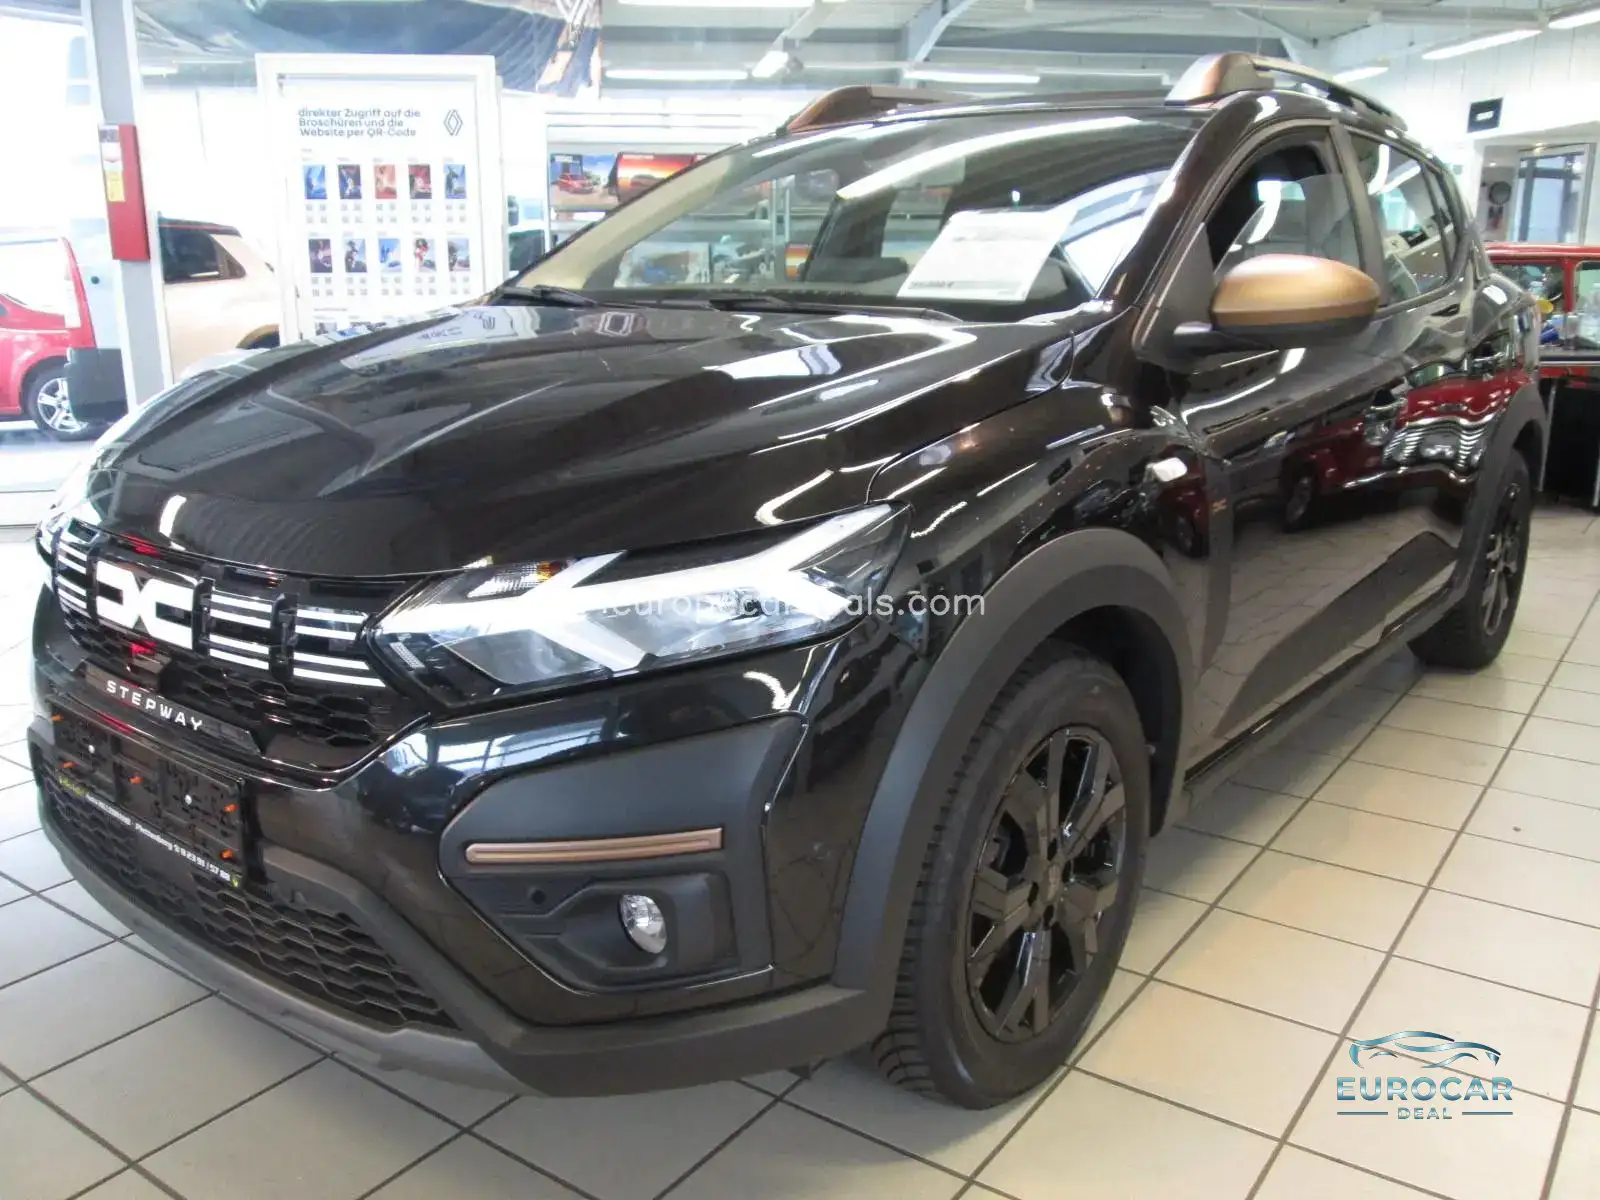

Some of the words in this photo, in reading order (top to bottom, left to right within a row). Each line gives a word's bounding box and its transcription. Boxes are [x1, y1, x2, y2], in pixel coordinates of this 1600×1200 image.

[298, 107, 342, 118] direkter
[344, 108, 382, 120] Zugriff
[384, 108, 402, 118] auf
[404, 107, 421, 118] die
[364, 118, 385, 127] und
[387, 117, 404, 127] die
[300, 127, 345, 137] Website
[346, 129, 365, 139] per
[367, 127, 417, 138] QR-Code
[106, 679, 203, 731] STEPWAY
